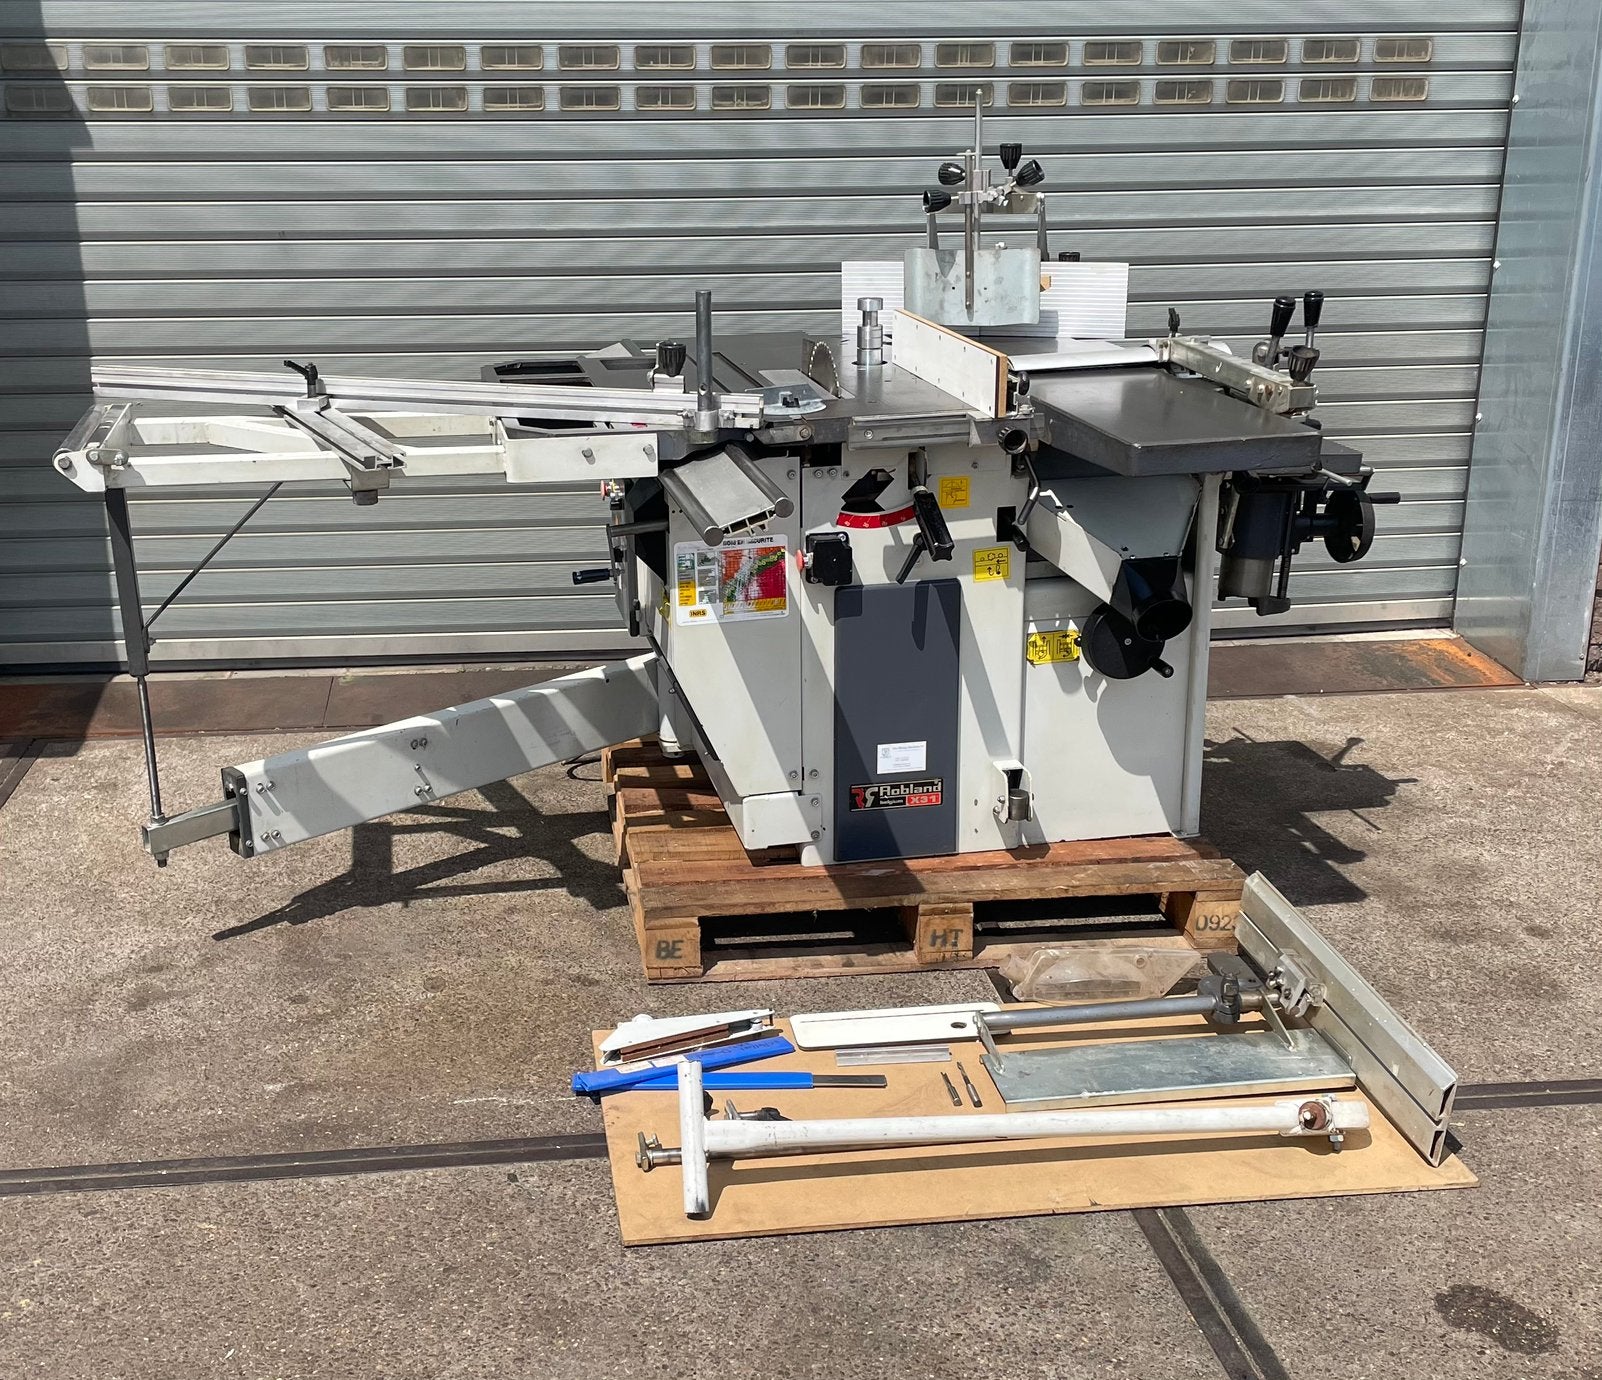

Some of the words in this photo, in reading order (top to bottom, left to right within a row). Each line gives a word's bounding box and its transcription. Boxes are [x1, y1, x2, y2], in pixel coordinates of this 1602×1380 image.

[880, 782, 941, 797] Robland
[910, 795, 937, 804] X31
[930, 928, 964, 948] HT
[655, 939, 684, 960] BE
